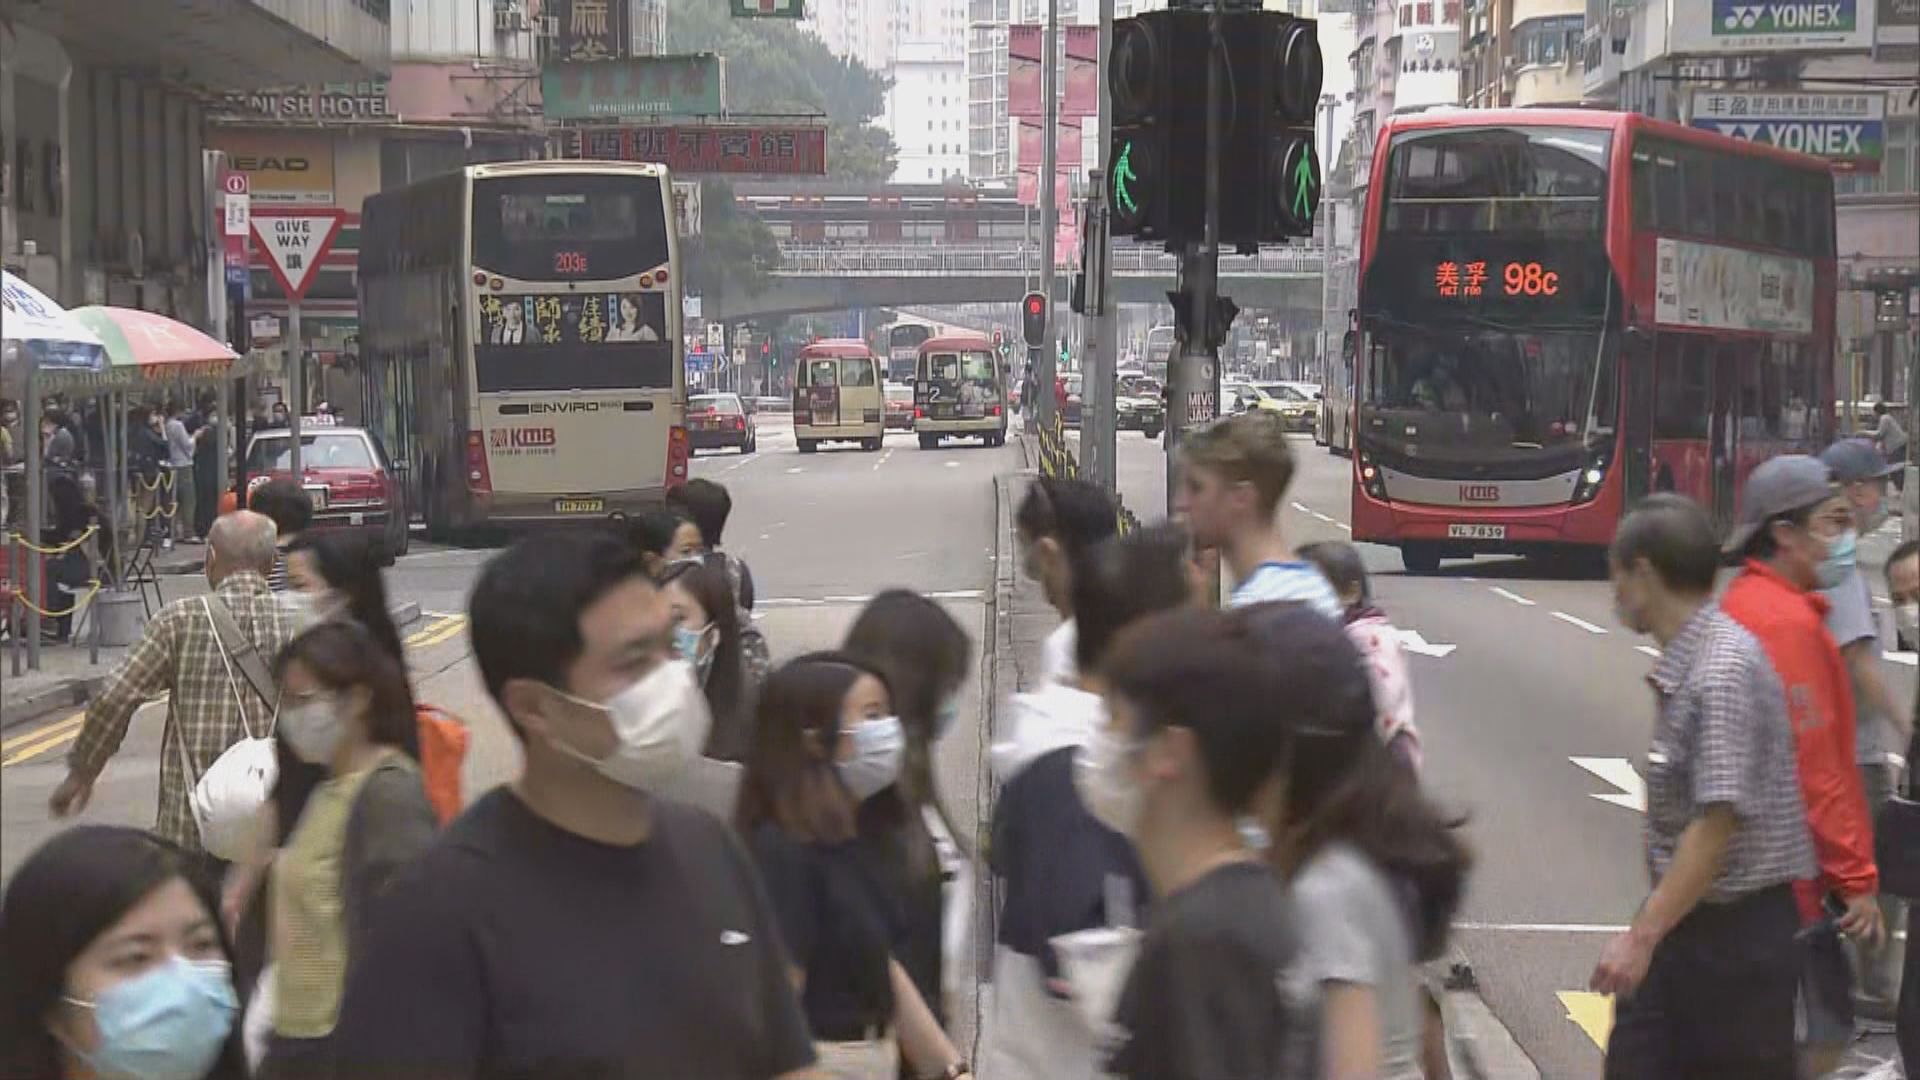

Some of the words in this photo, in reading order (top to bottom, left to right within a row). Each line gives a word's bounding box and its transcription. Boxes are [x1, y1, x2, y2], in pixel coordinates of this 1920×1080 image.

[1769, 4, 1841, 28] YONEX
[321, 95, 395, 117] HOTEL
[1767, 123, 1863, 154] YONEX
[275, 220, 311, 233] GIVE
[276, 235, 310, 248] WAY
[530, 401, 599, 413] ENVIRO
[510, 427, 556, 447] KMB
[1459, 485, 1499, 501] KMB
[1451, 526, 1465, 537] VL
